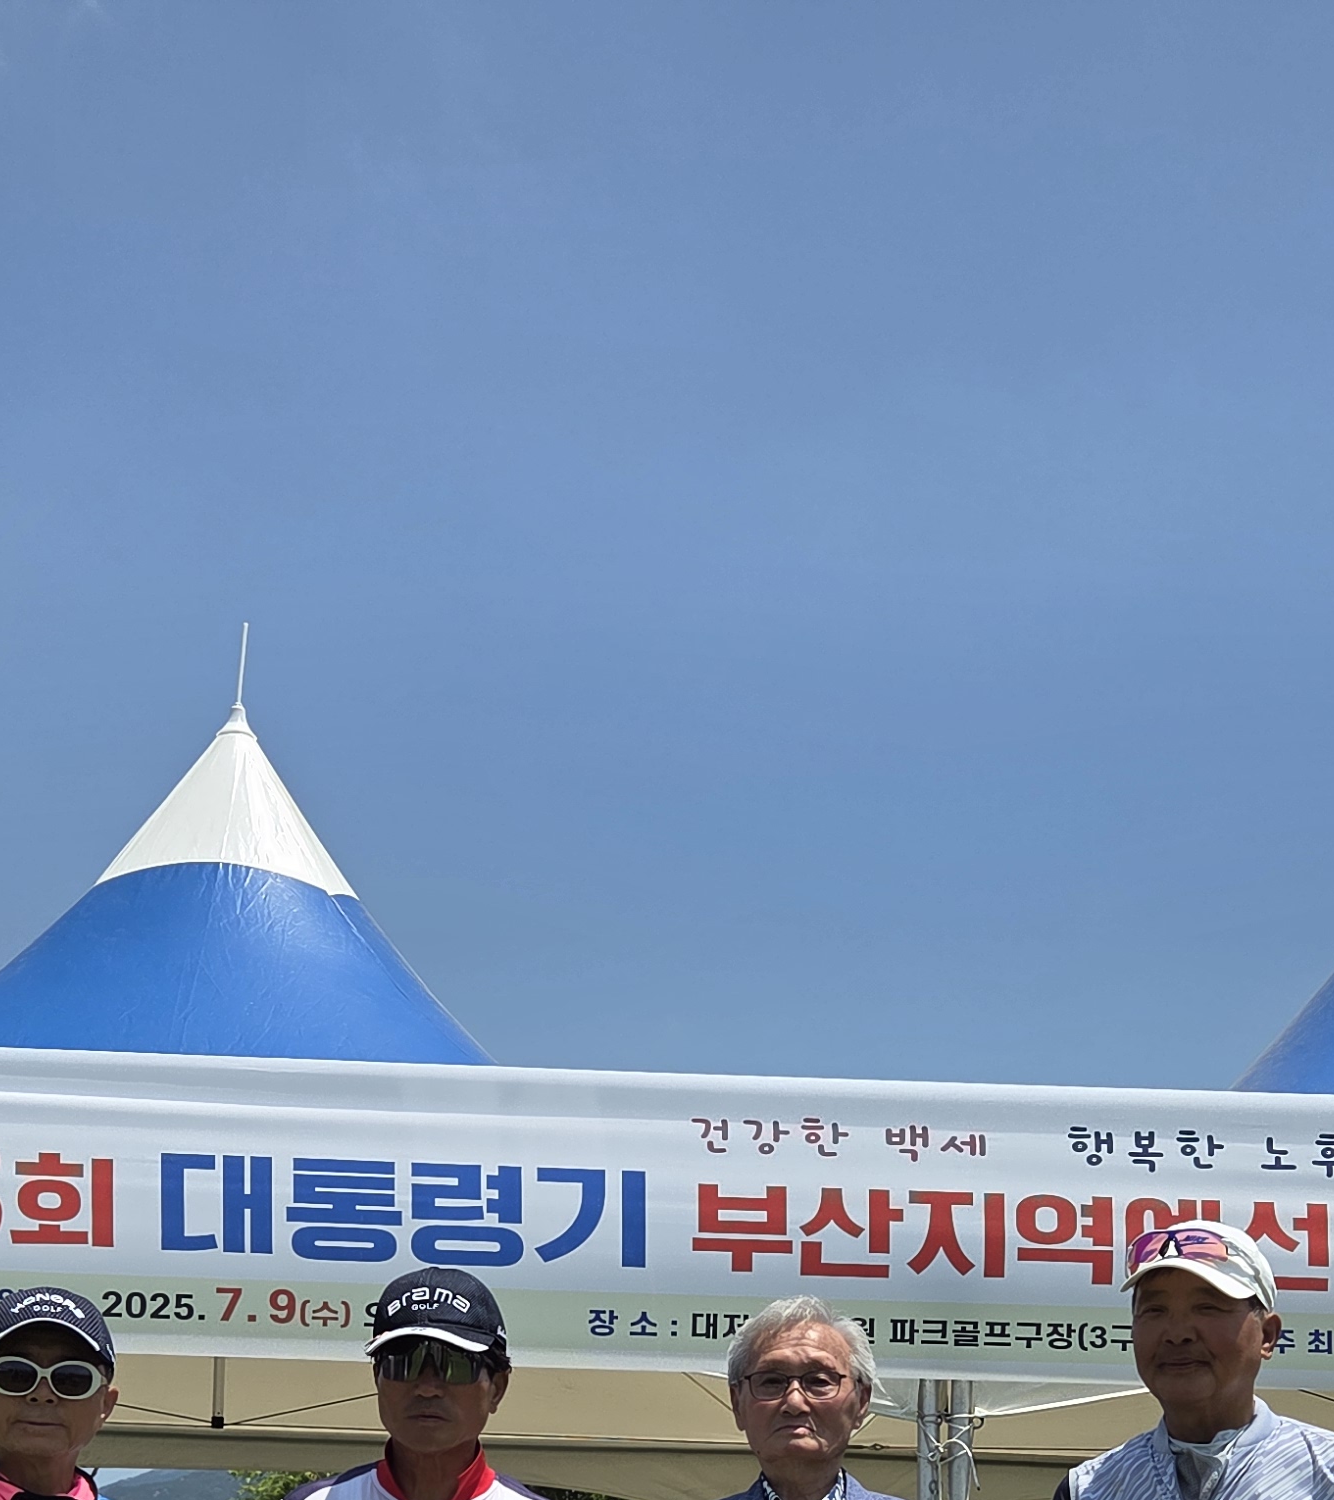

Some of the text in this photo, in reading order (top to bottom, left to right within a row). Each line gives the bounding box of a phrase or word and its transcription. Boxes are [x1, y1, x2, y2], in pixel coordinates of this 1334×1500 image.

[691, 1117, 849, 1157] 건강한
[885, 1124, 987, 1162] 백세
[1067, 1126, 1225, 1173] 행복한
[160, 1152, 647, 1268] 대통령기
[33, 1304, 63, 1313] GOLF
[101, 1290, 206, 1321] 2025.
[411, 1302, 440, 1311] GOLF
